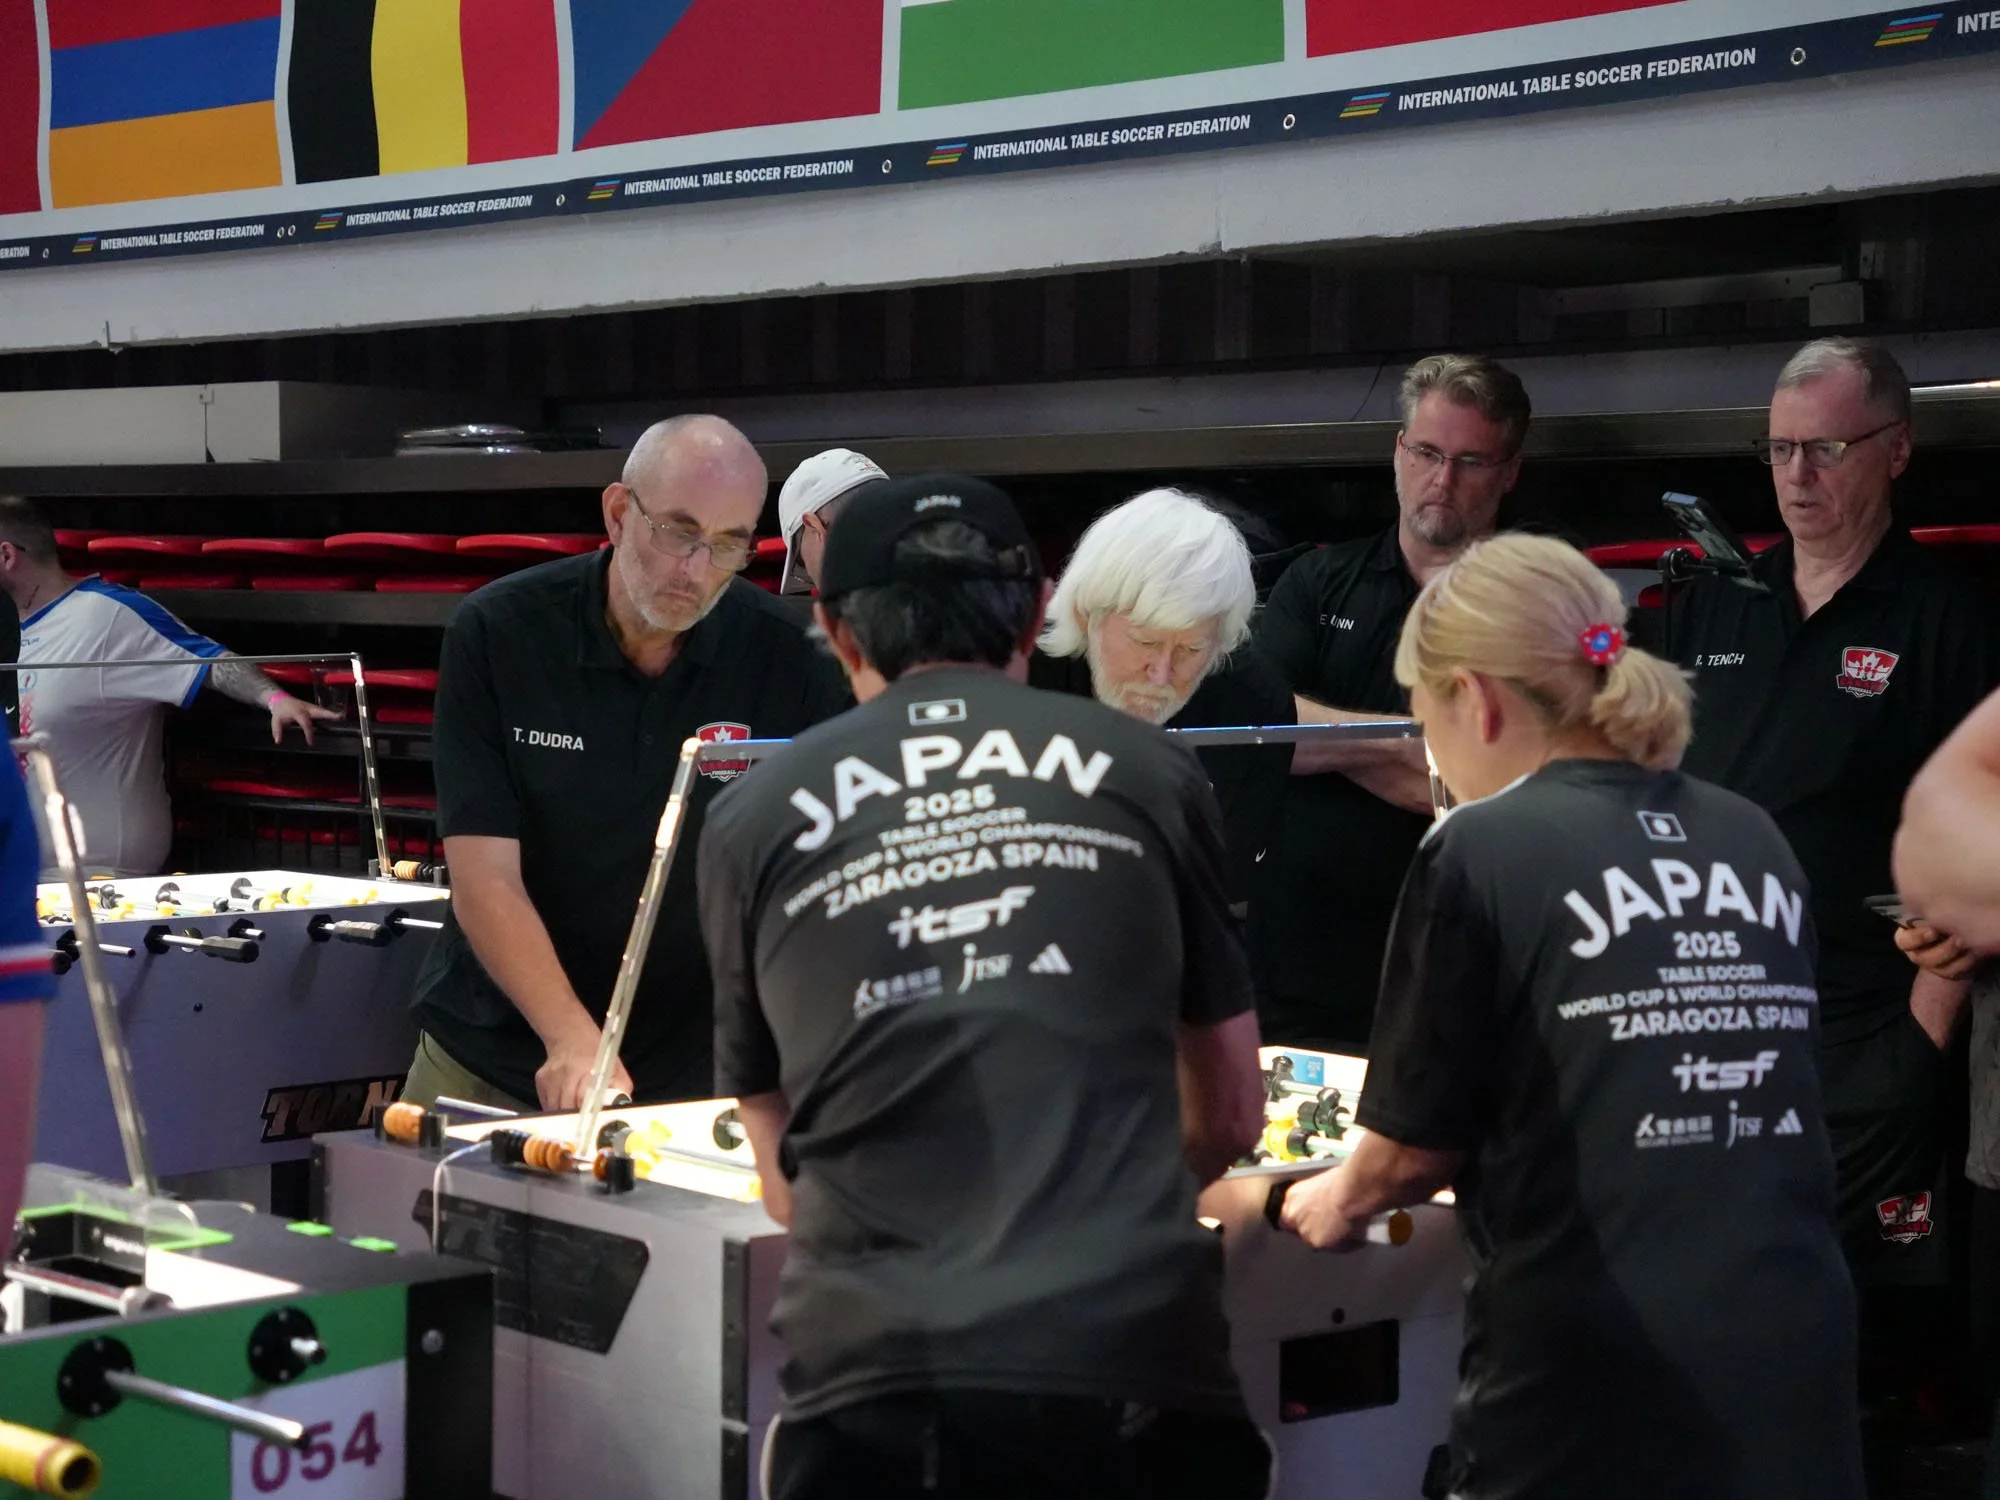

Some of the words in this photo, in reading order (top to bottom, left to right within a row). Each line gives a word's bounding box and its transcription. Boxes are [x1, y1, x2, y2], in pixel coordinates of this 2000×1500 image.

[1957, 10, 2000, 34] INTE
[1398, 81, 1518, 111] INTERNATIONAL
[1522, 73, 1571, 95] TABLE
[1574, 63, 1642, 88] SOCCER
[1647, 47, 1757, 79] FEDERATION
[973, 136, 1068, 160] INTERNATIONAL
[1071, 131, 1109, 148] TABLE
[1111, 125, 1164, 145] SOCCER
[1167, 114, 1251, 138] FEDERATION
[624, 175, 700, 195] INTERNATIONAL
[702, 171, 733, 186] TABLE
[735, 166, 781, 183] SOCCER
[783, 159, 854, 179] FEDERATION
[346, 209, 411, 227] INTERNATIONAL
[413, 206, 439, 219] TABLE
[440, 202, 476, 216] SOCCER
[476, 194, 534, 212] FEDERATION
[101, 236, 158, 250] INTERNATIONAL
[159, 233, 182, 245] TABLE
[183, 229, 215, 243] SOCCER
[215, 224, 265, 240] FEDERATION
[1707, 652, 1745, 667] TENCH
[513, 727, 525, 743] T.
[528, 730, 584, 751] DUDRA
[789, 729, 1113, 852] JAPAN
[904, 784, 996, 822] 2025
[878, 820, 939, 847] TABLE
[940, 807, 1027, 836] SOCCER
[783, 872, 841, 918] WORLD
[842, 851, 883, 880] CUP
[900, 830, 978, 861] WORLD
[823, 847, 999, 920] ZARAGOZA
[1001, 843, 1099, 872] SPAIN
[1563, 858, 1803, 960] JAPAN
[1672, 930, 1742, 960] 2025
[1657, 966, 1705, 984] TABLE
[1705, 964, 1767, 981] SOCCER
[1557, 992, 1626, 1020] WORLD
[1626, 989, 1665, 1007] CUP
[1667, 987, 1678, 1005] &
[1679, 985, 1736, 1003] WORLD
[1609, 1006, 1753, 1041] ZARAGOZA
[1754, 1006, 1809, 1031] SPAIN
[250, 1411, 382, 1494] 054
